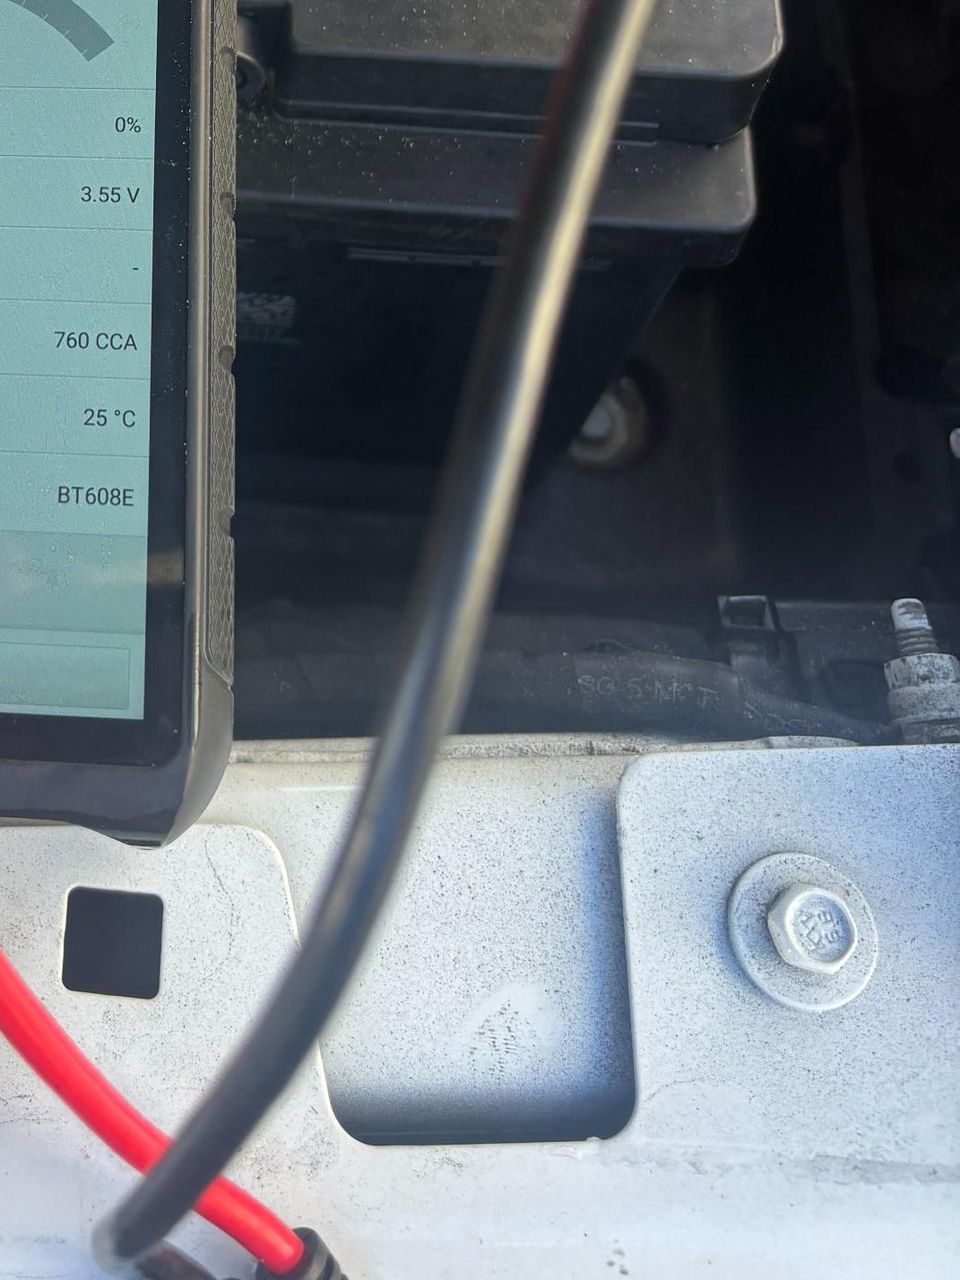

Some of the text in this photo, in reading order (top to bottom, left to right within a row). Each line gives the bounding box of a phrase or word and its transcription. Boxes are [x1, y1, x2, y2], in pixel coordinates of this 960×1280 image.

[113, 116, 142, 134] 0%
[79, 186, 121, 204] 3.55
[124, 187, 141, 204] V
[53, 331, 90, 350] 760
[94, 332, 138, 351] CCA
[82, 408, 108, 427] 25
[113, 408, 136, 427] °C
[56, 486, 135, 507] BT608E
